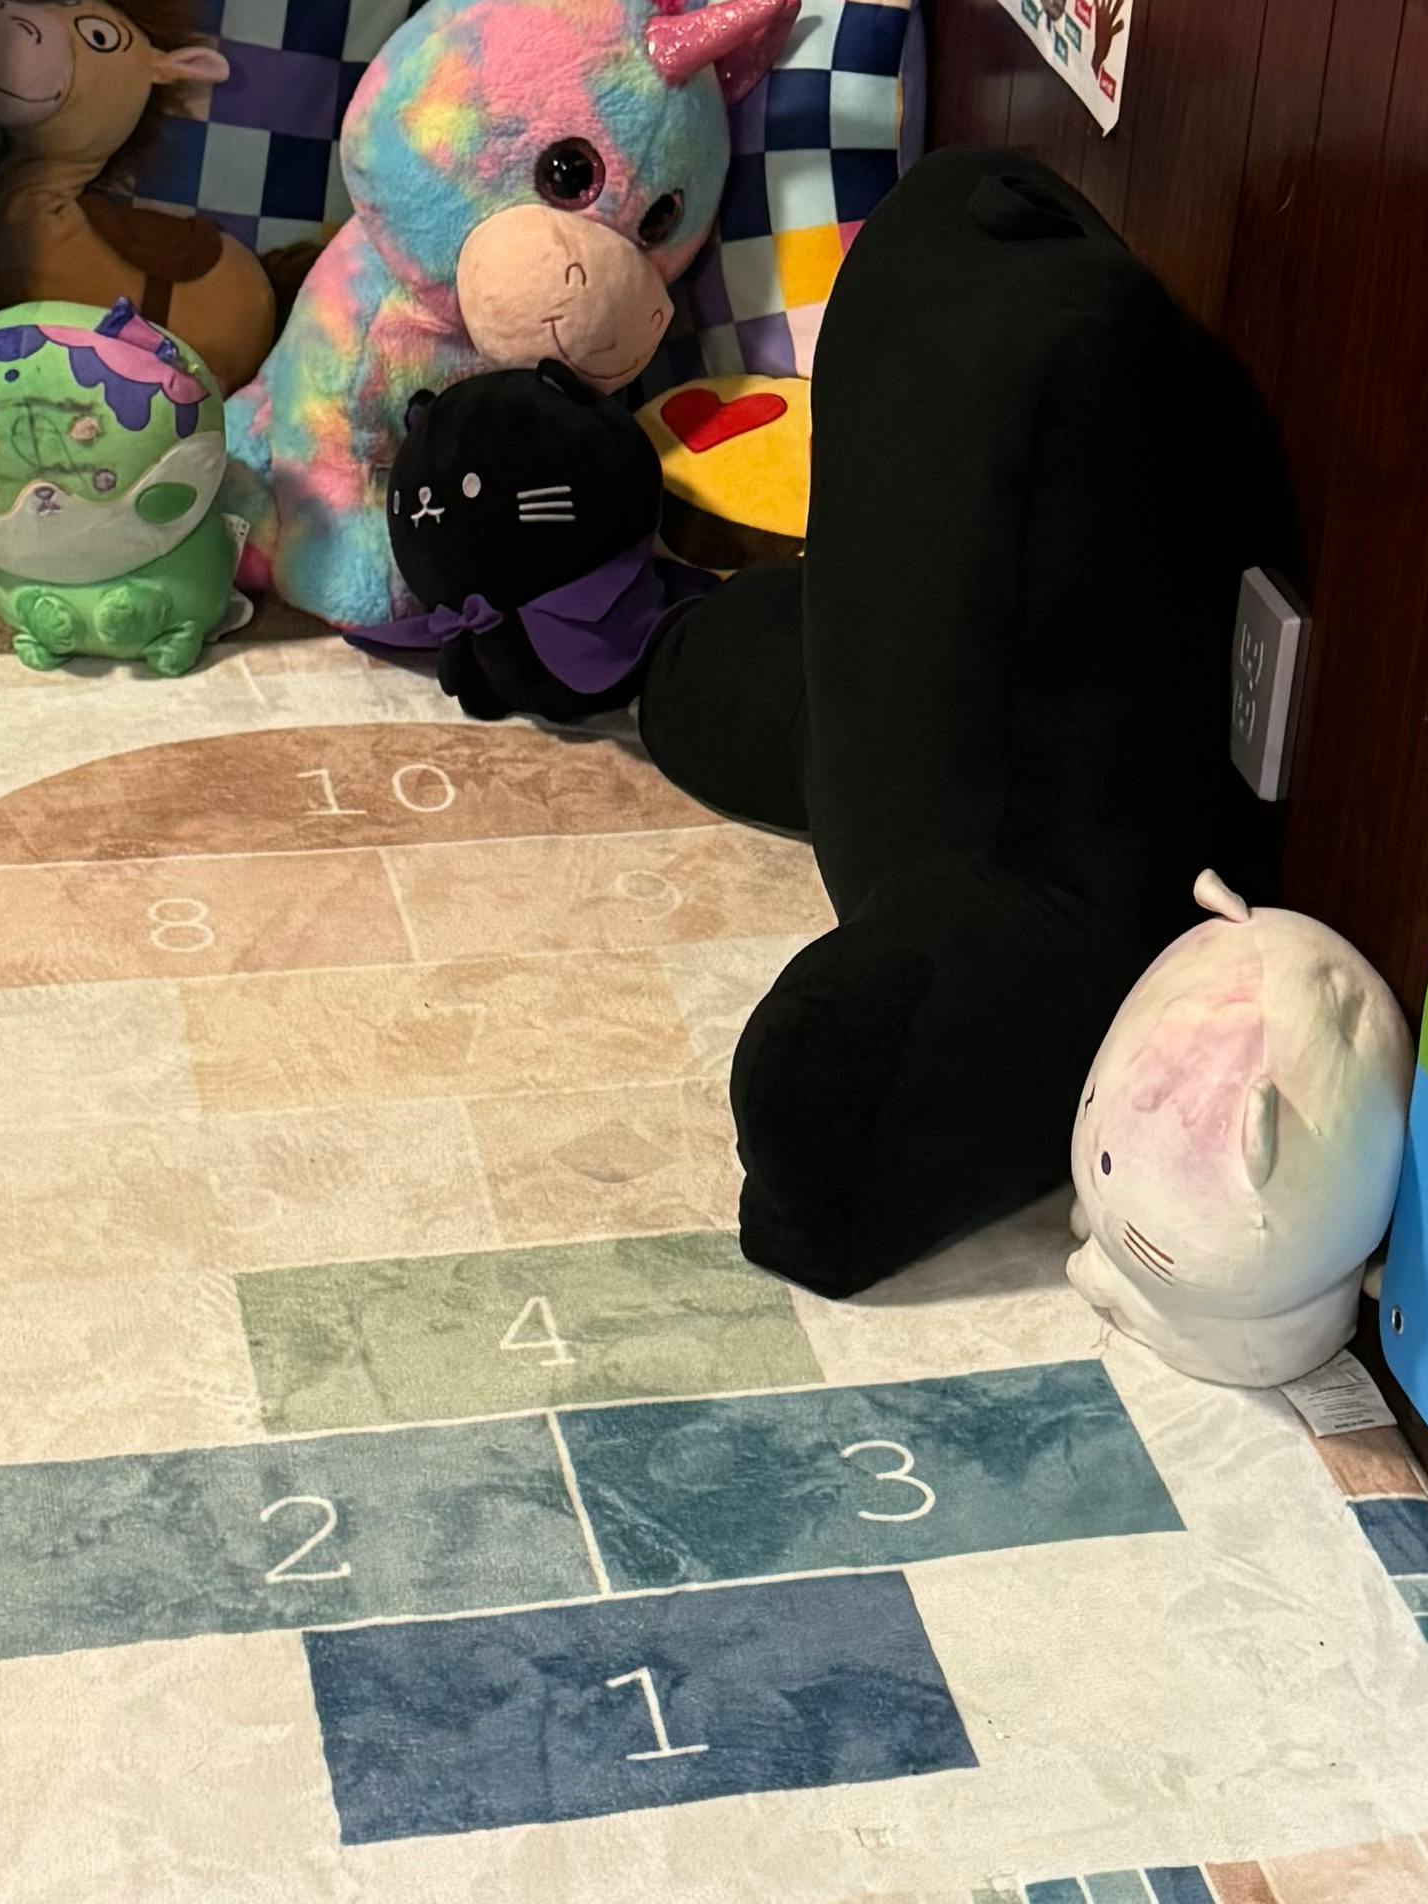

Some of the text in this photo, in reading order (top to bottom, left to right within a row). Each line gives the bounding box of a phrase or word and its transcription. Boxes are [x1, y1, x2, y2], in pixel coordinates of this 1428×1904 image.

[296, 763, 456, 816] 10
[146, 897, 216, 954] 8
[614, 869, 683, 922] 9
[498, 1294, 579, 1368] 4
[838, 1438, 942, 1526] 3
[258, 1494, 355, 1588] 2
[605, 1667, 712, 1768] 1
